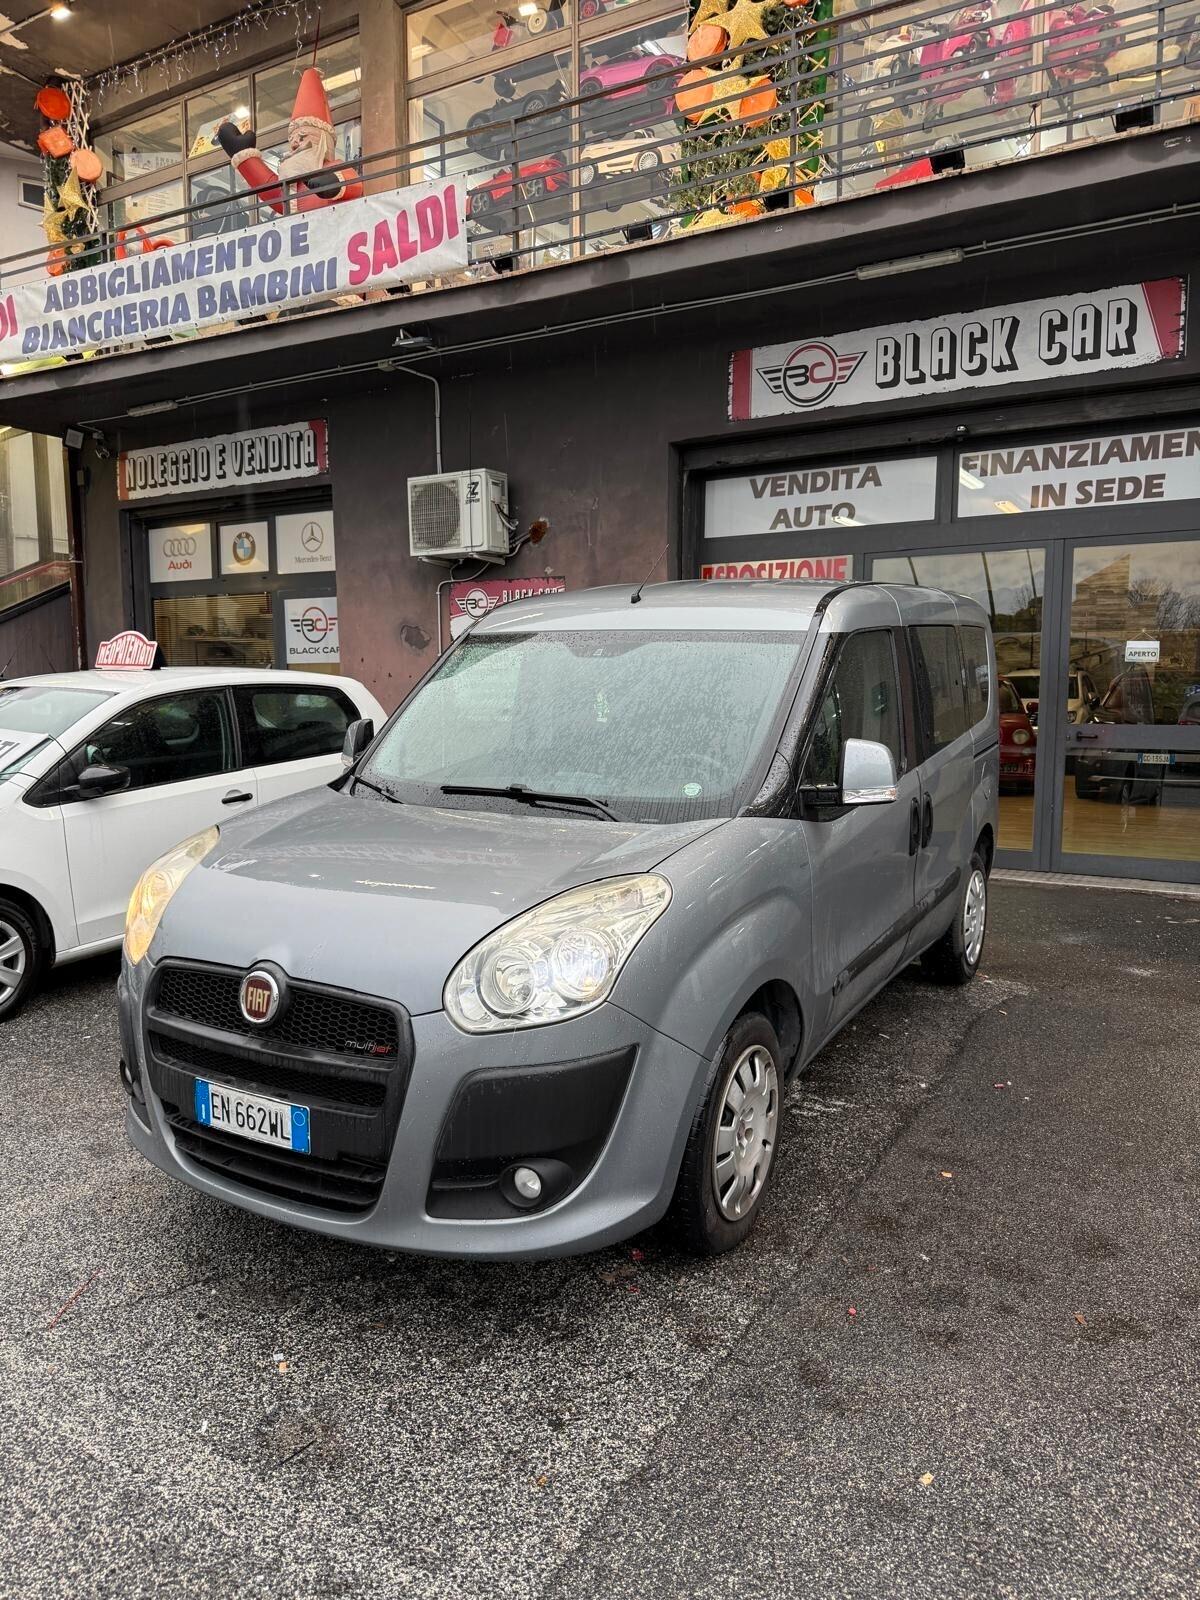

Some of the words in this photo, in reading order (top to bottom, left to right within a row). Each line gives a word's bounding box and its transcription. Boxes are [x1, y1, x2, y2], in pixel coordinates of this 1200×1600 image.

[347, 184, 460, 286] SALDI
[43, 227, 282, 314] ABBIGLIAMENTO
[291, 222, 310, 255] E
[22, 292, 191, 354] BIANCHERIA
[197, 256, 338, 319] BAMBINI
[875, 316, 1020, 390] BLACK
[1038, 298, 1137, 365] CAR
[126, 446, 210, 491] NOLEGGIO
[215, 444, 227, 479] E
[231, 429, 319, 476] VENDITA
[749, 465, 882, 499] VENDITA
[1030, 482, 1067, 508] IN
[1075, 473, 1166, 505] SEDE
[769, 502, 856, 530] AUTO
[168, 559, 192, 571] Audi
[97, 634, 154, 666] NEOPATENTATI
[290, 647, 320, 655] BLACK
[247, 986, 270, 1013] FIAT
[345, 1040, 392, 1053] multijet
[211, 1092, 230, 1124] EN
[235, 1101, 291, 1140] 662WL
